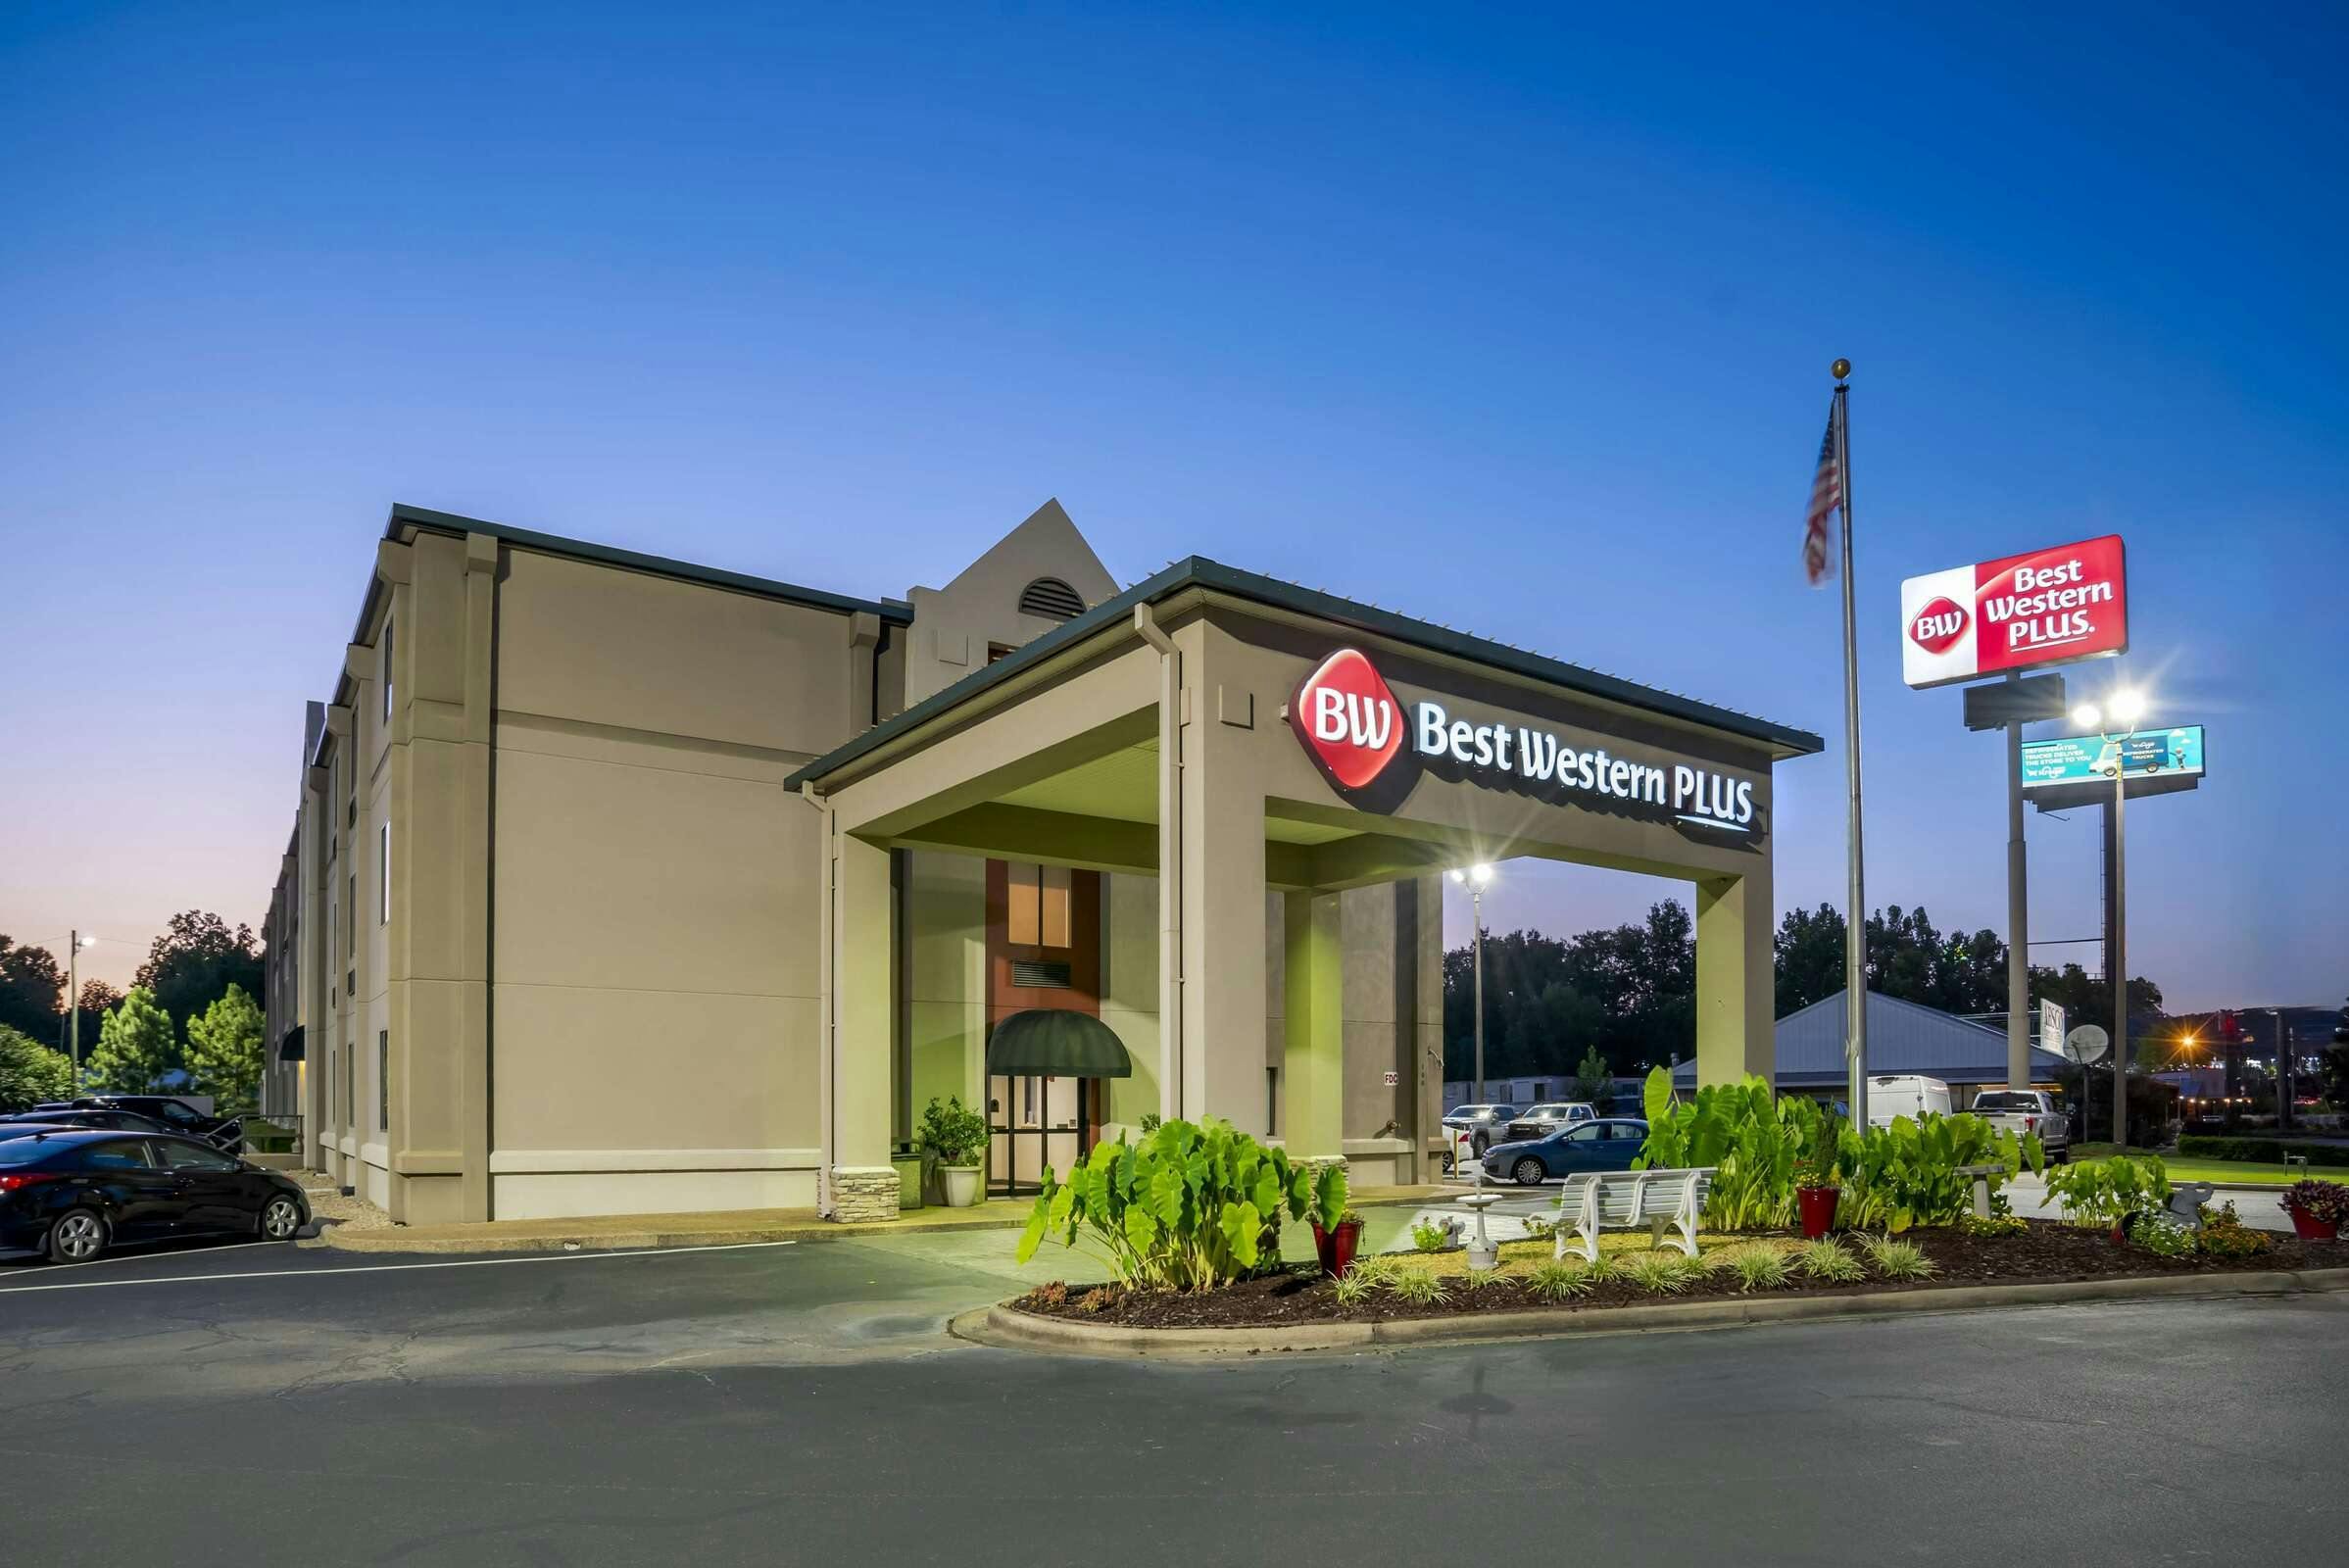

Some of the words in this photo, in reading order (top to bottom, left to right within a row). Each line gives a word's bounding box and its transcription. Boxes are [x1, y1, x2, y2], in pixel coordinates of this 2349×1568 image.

[2014, 559, 2083, 593] Best
[1984, 581, 2114, 623] Western
[1917, 611, 1963, 641] BW
[1315, 687, 1392, 751] BW
[1418, 702, 1512, 772] Best
[1517, 727, 1666, 806] Western
[1674, 765, 1753, 824] PLUS
[1385, 1074, 1397, 1084] FDC
